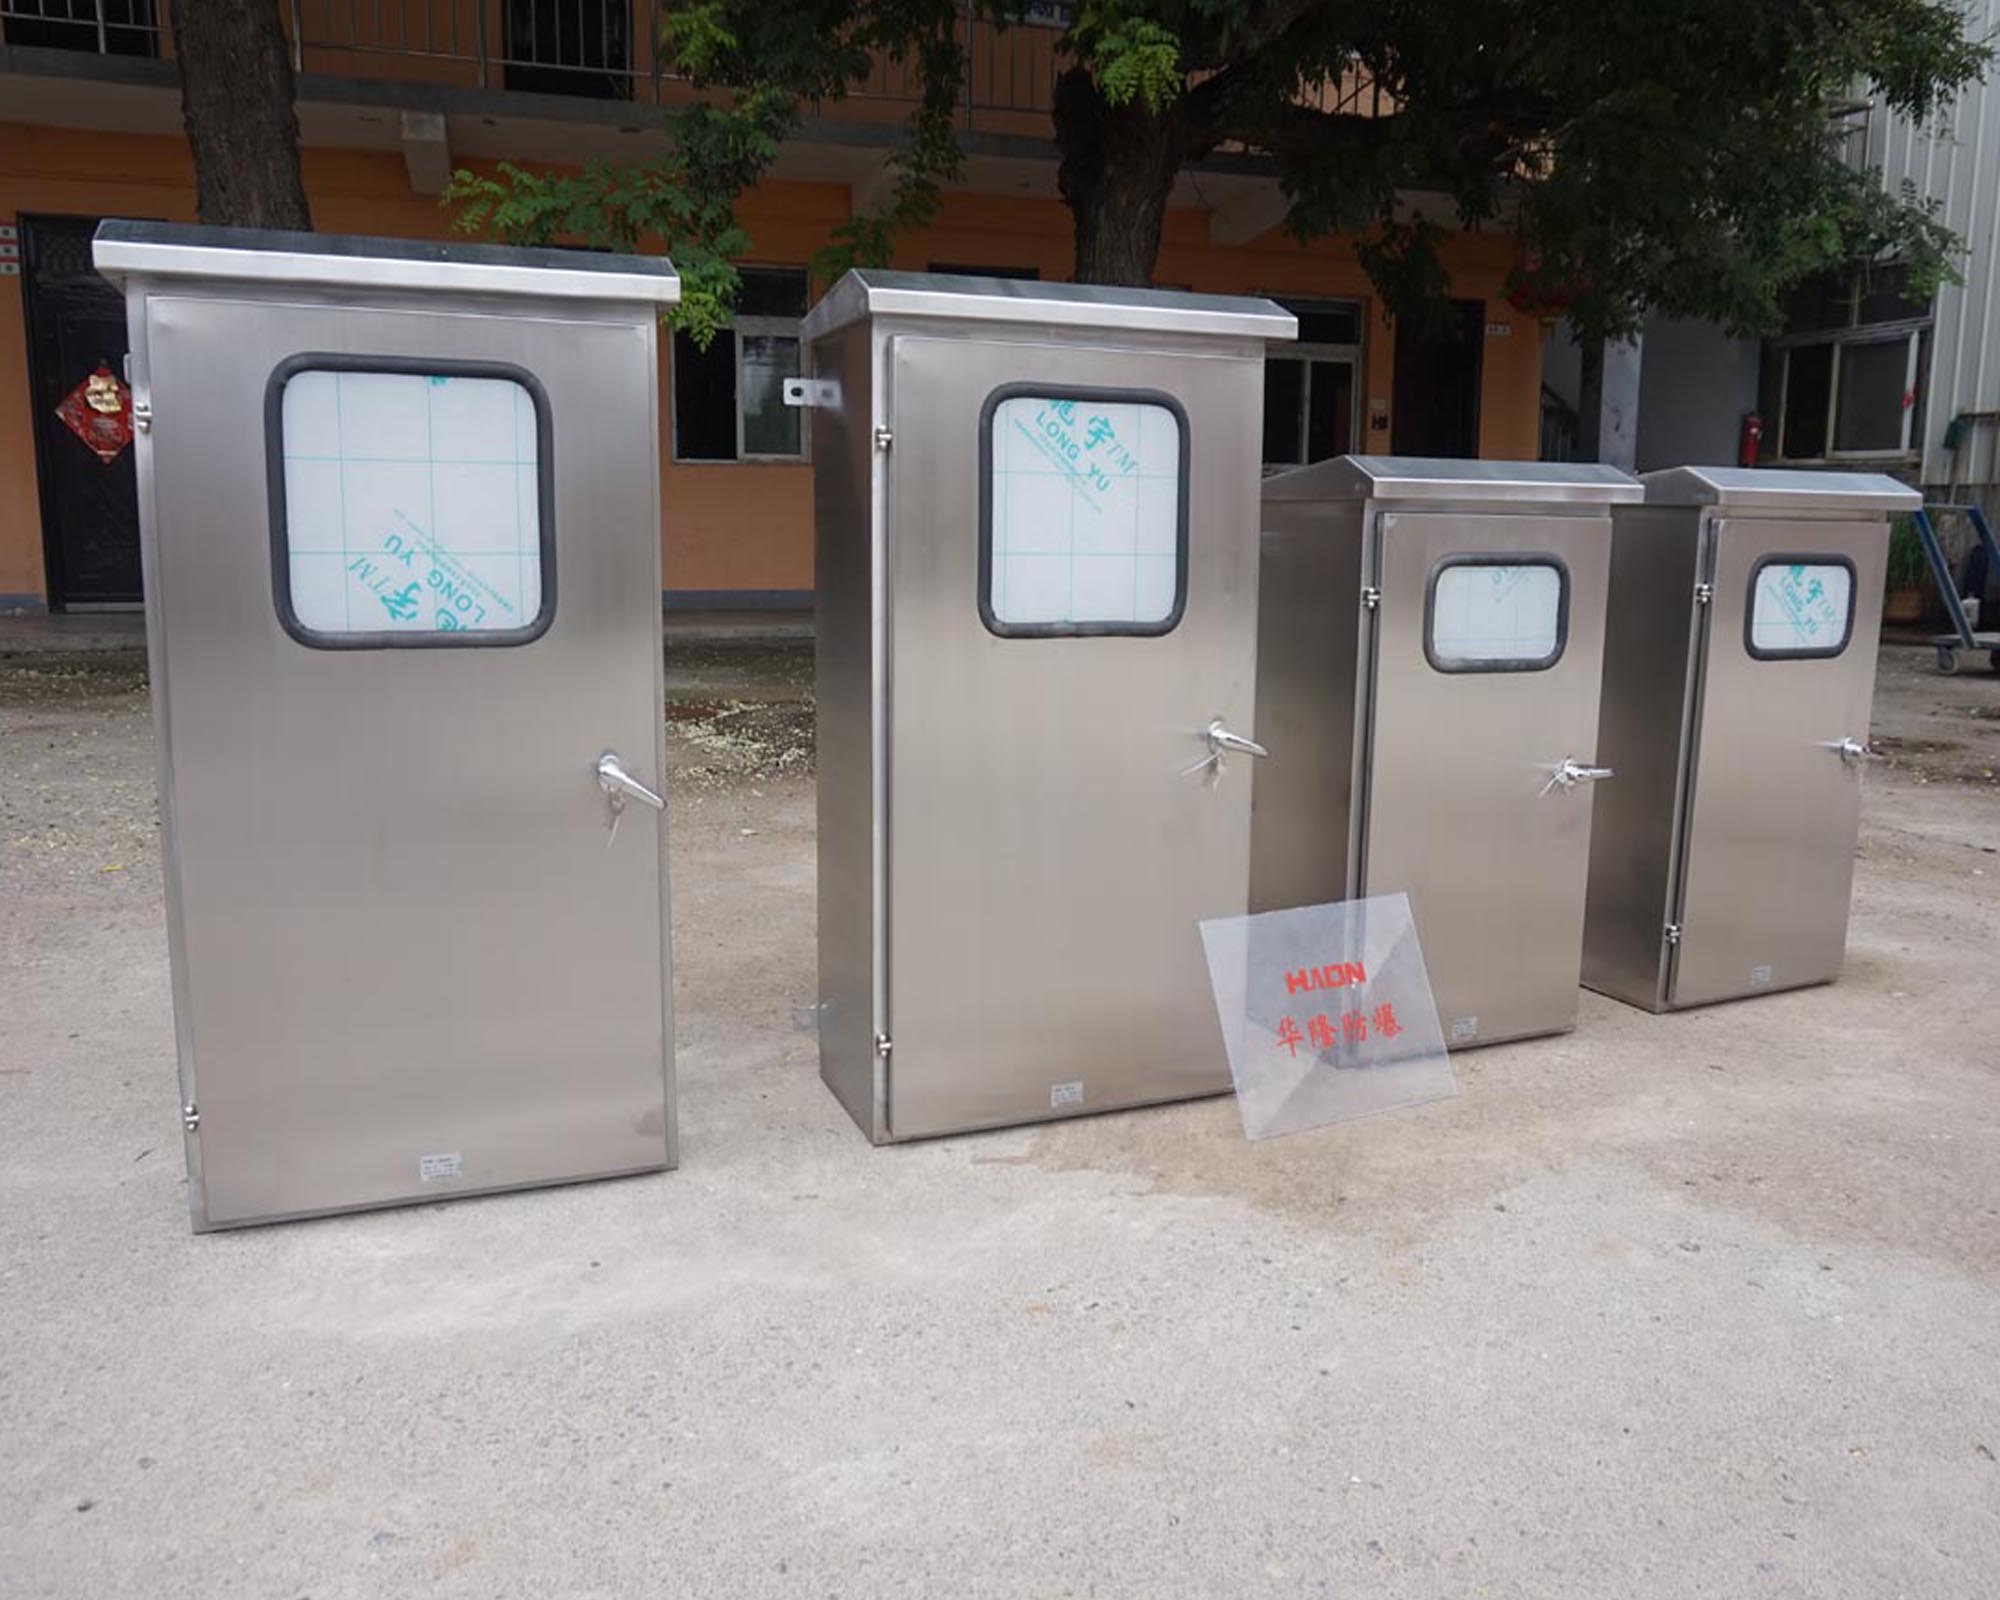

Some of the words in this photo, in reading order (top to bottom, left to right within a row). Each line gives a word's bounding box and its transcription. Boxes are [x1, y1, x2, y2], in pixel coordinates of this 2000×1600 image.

[1035, 411, 1081, 460] LONG
[1087, 463, 1111, 491] YU
[384, 533, 416, 570] YU
[427, 568, 487, 623] LONG
